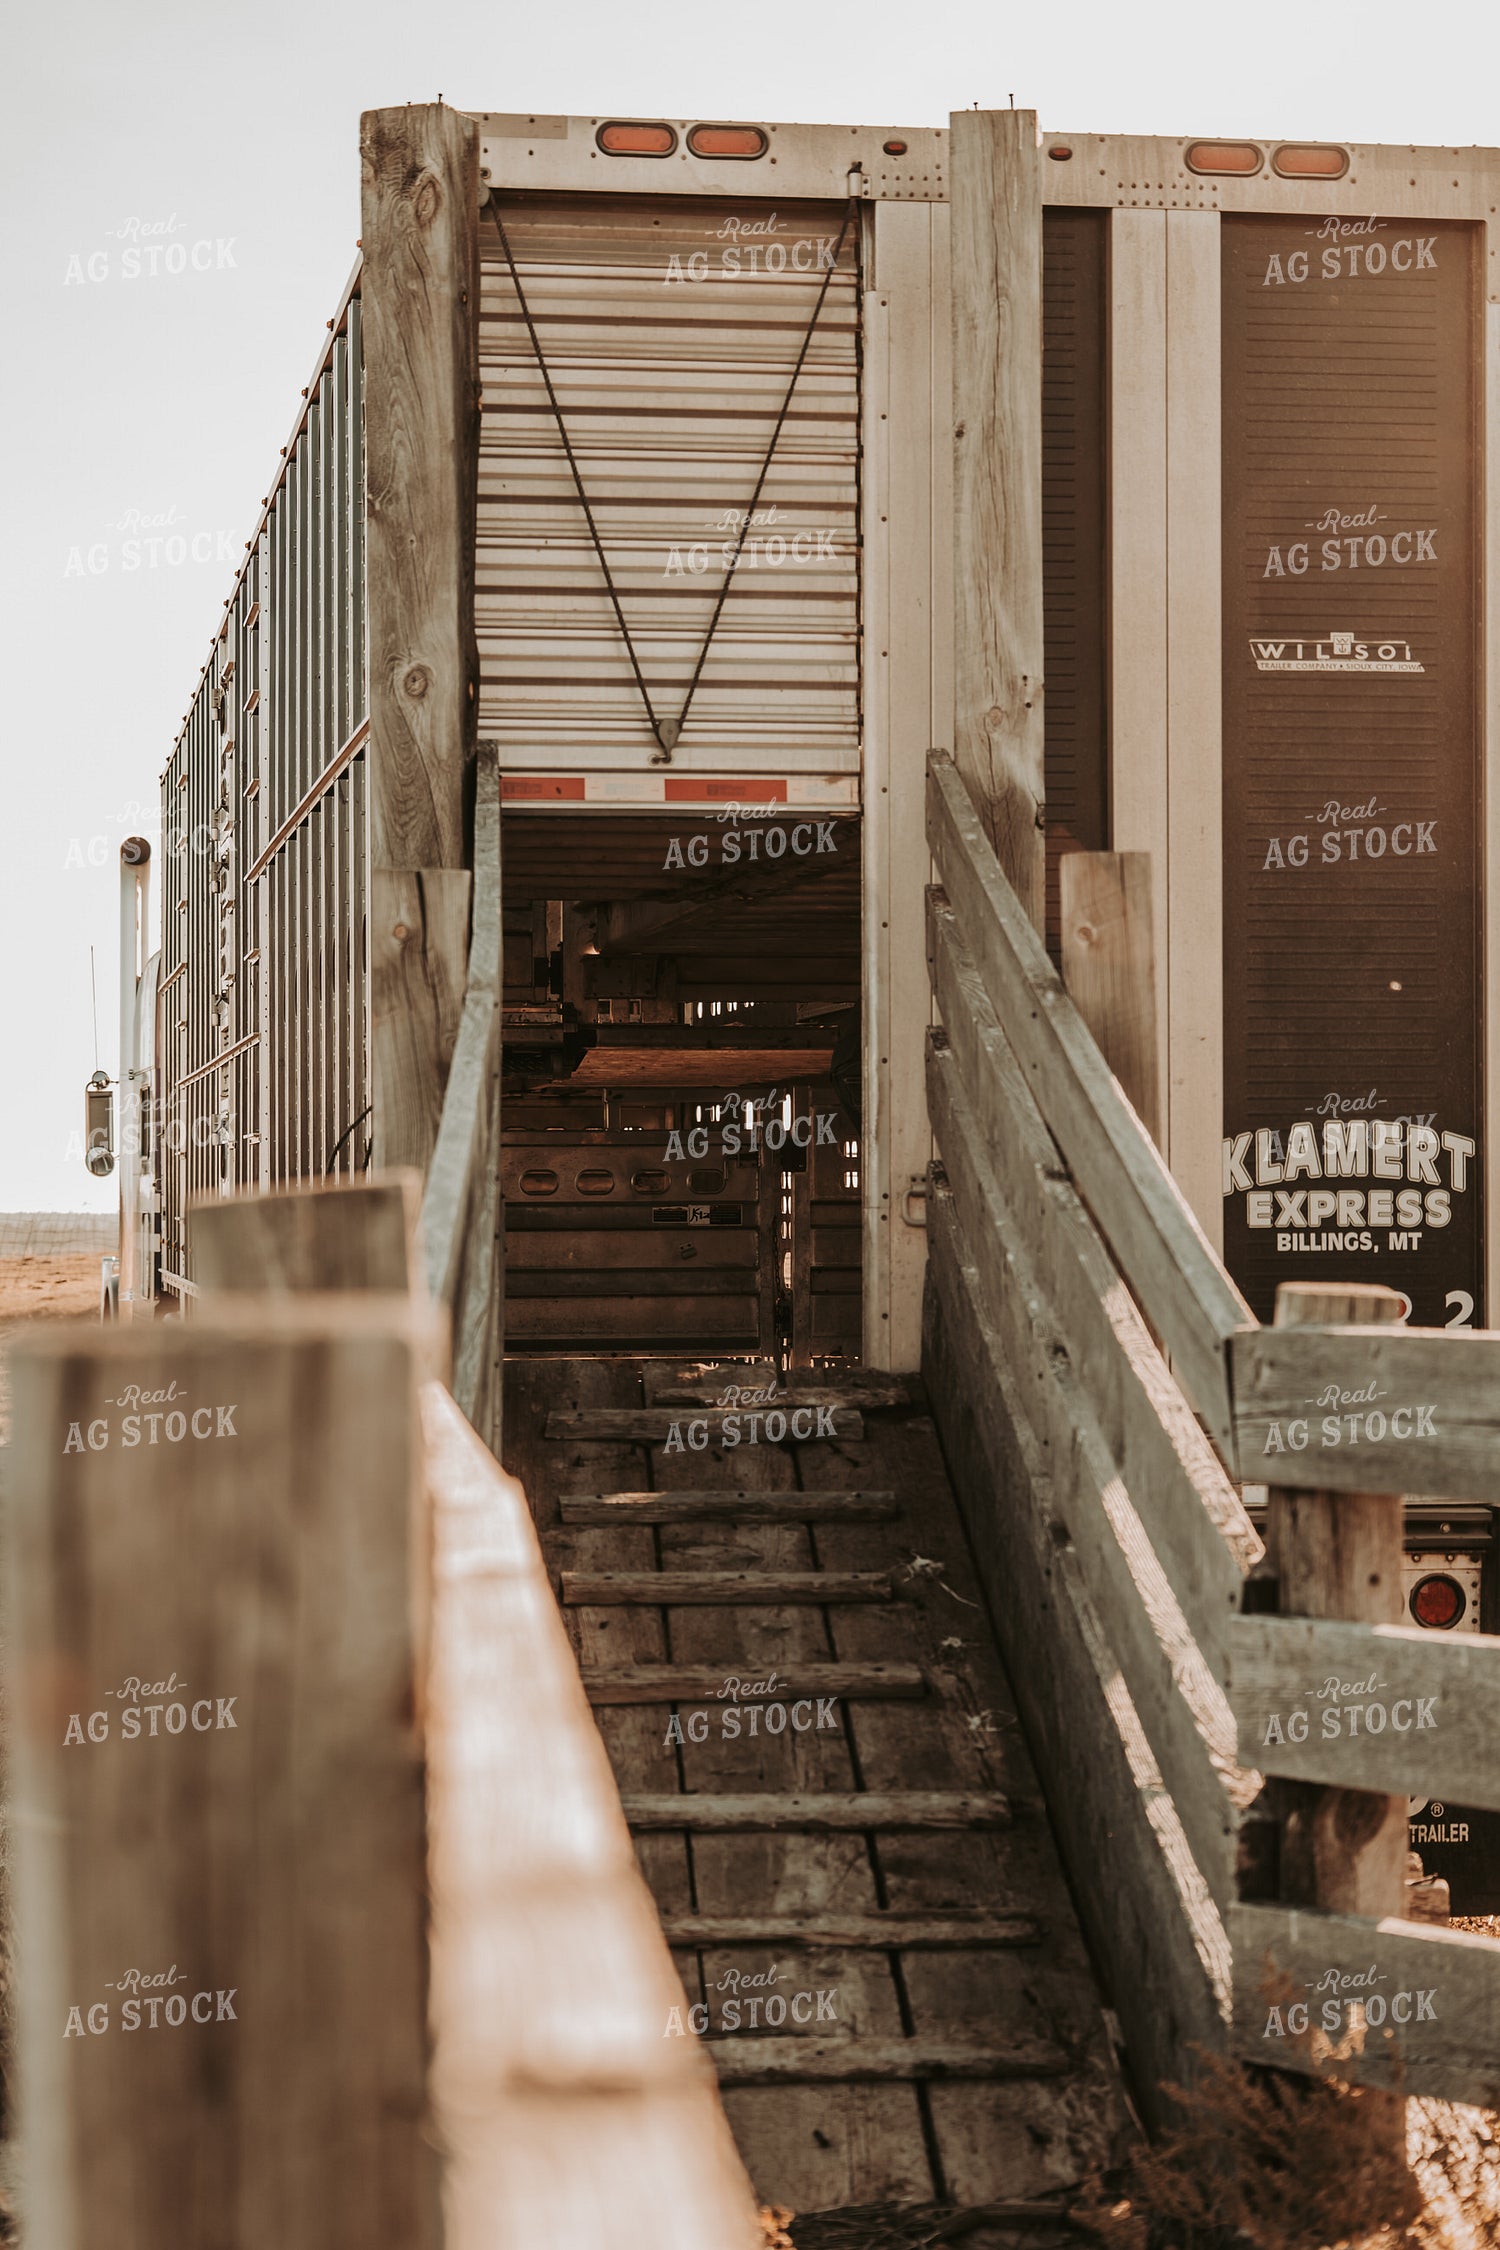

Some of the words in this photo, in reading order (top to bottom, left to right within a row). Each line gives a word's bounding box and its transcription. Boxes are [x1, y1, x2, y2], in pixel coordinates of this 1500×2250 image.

[1257, 643, 1411, 660] WILSO
[1261, 662, 1292, 670] TRAILER
[1296, 662, 1338, 670] COMPANY
[1346, 663, 1372, 671] SIOUX
[1223, 1120, 1475, 1196] KLAMERT
[1247, 1189, 1452, 1228] EXPRESS
[1277, 1231, 1379, 1254] BILLINGS,
[1389, 1232, 1422, 1251] MT
[1408, 1823, 1469, 1843] TRAILER
